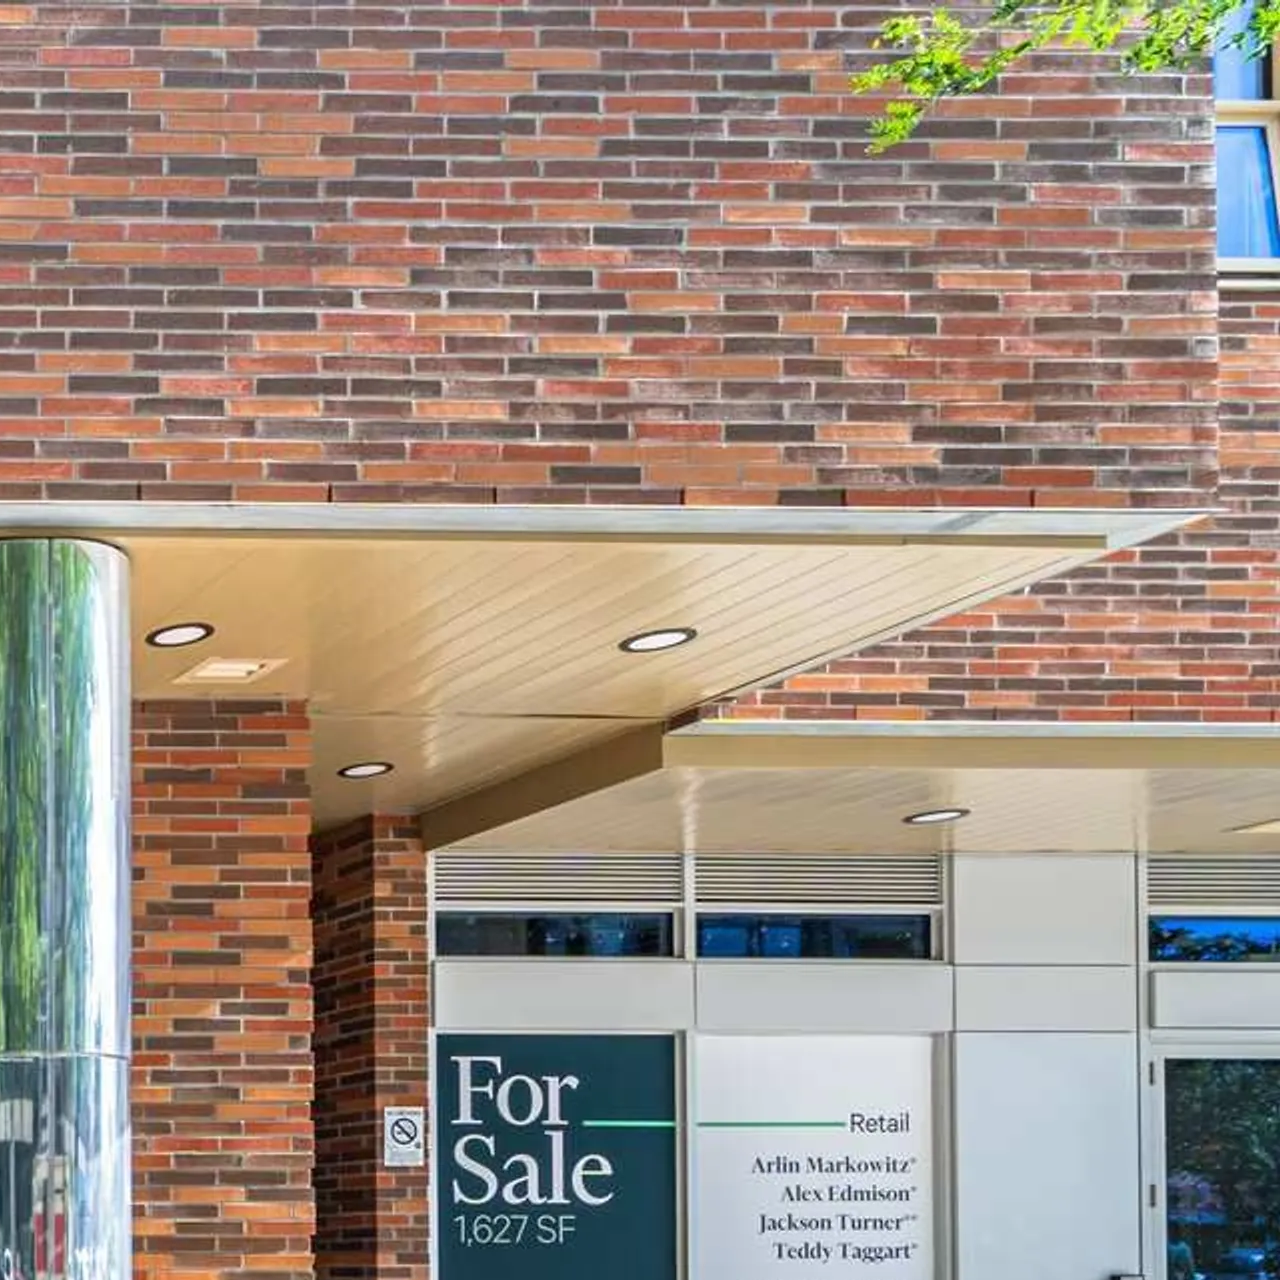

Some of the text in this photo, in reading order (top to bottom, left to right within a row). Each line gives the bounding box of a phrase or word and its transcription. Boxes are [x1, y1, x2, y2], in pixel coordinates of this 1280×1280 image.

[450, 1056, 579, 1126] For
[850, 1112, 909, 1133] Retail
[452, 1130, 614, 1205] Sale
[752, 1156, 800, 1174] Arlin
[782, 1185, 823, 1202] Alex
[454, 1214, 576, 1246] 1,627 SF
[758, 1214, 832, 1234] Jackson
[773, 1242, 832, 1263] Teddy
